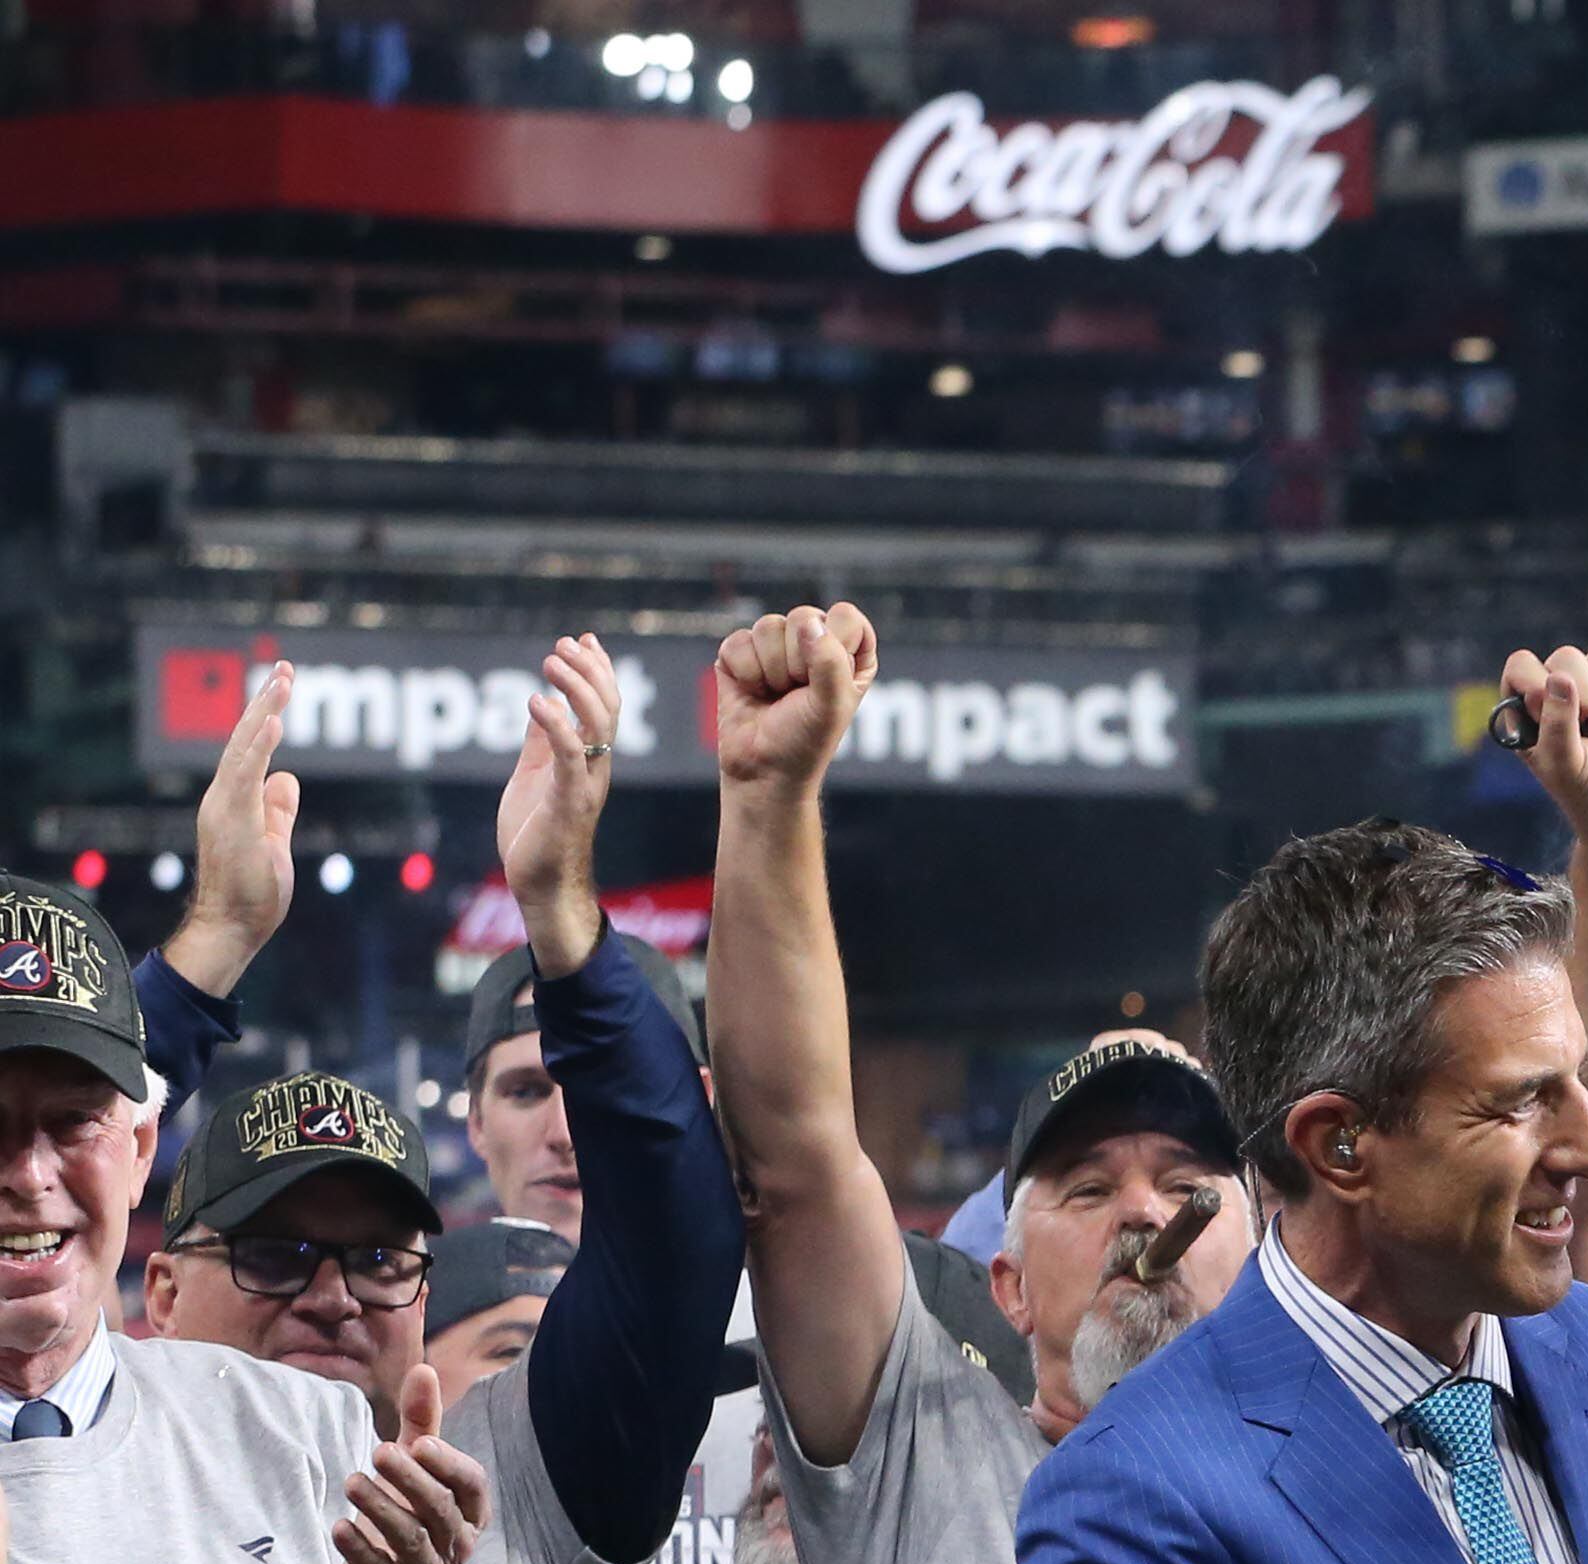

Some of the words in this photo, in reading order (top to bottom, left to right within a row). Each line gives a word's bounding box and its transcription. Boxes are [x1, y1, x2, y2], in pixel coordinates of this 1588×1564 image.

[246, 634, 657, 769] impat
[836, 668, 1180, 781] mpact
[57, 976, 75, 1001] 21
[278, 1129, 298, 1150] 20
